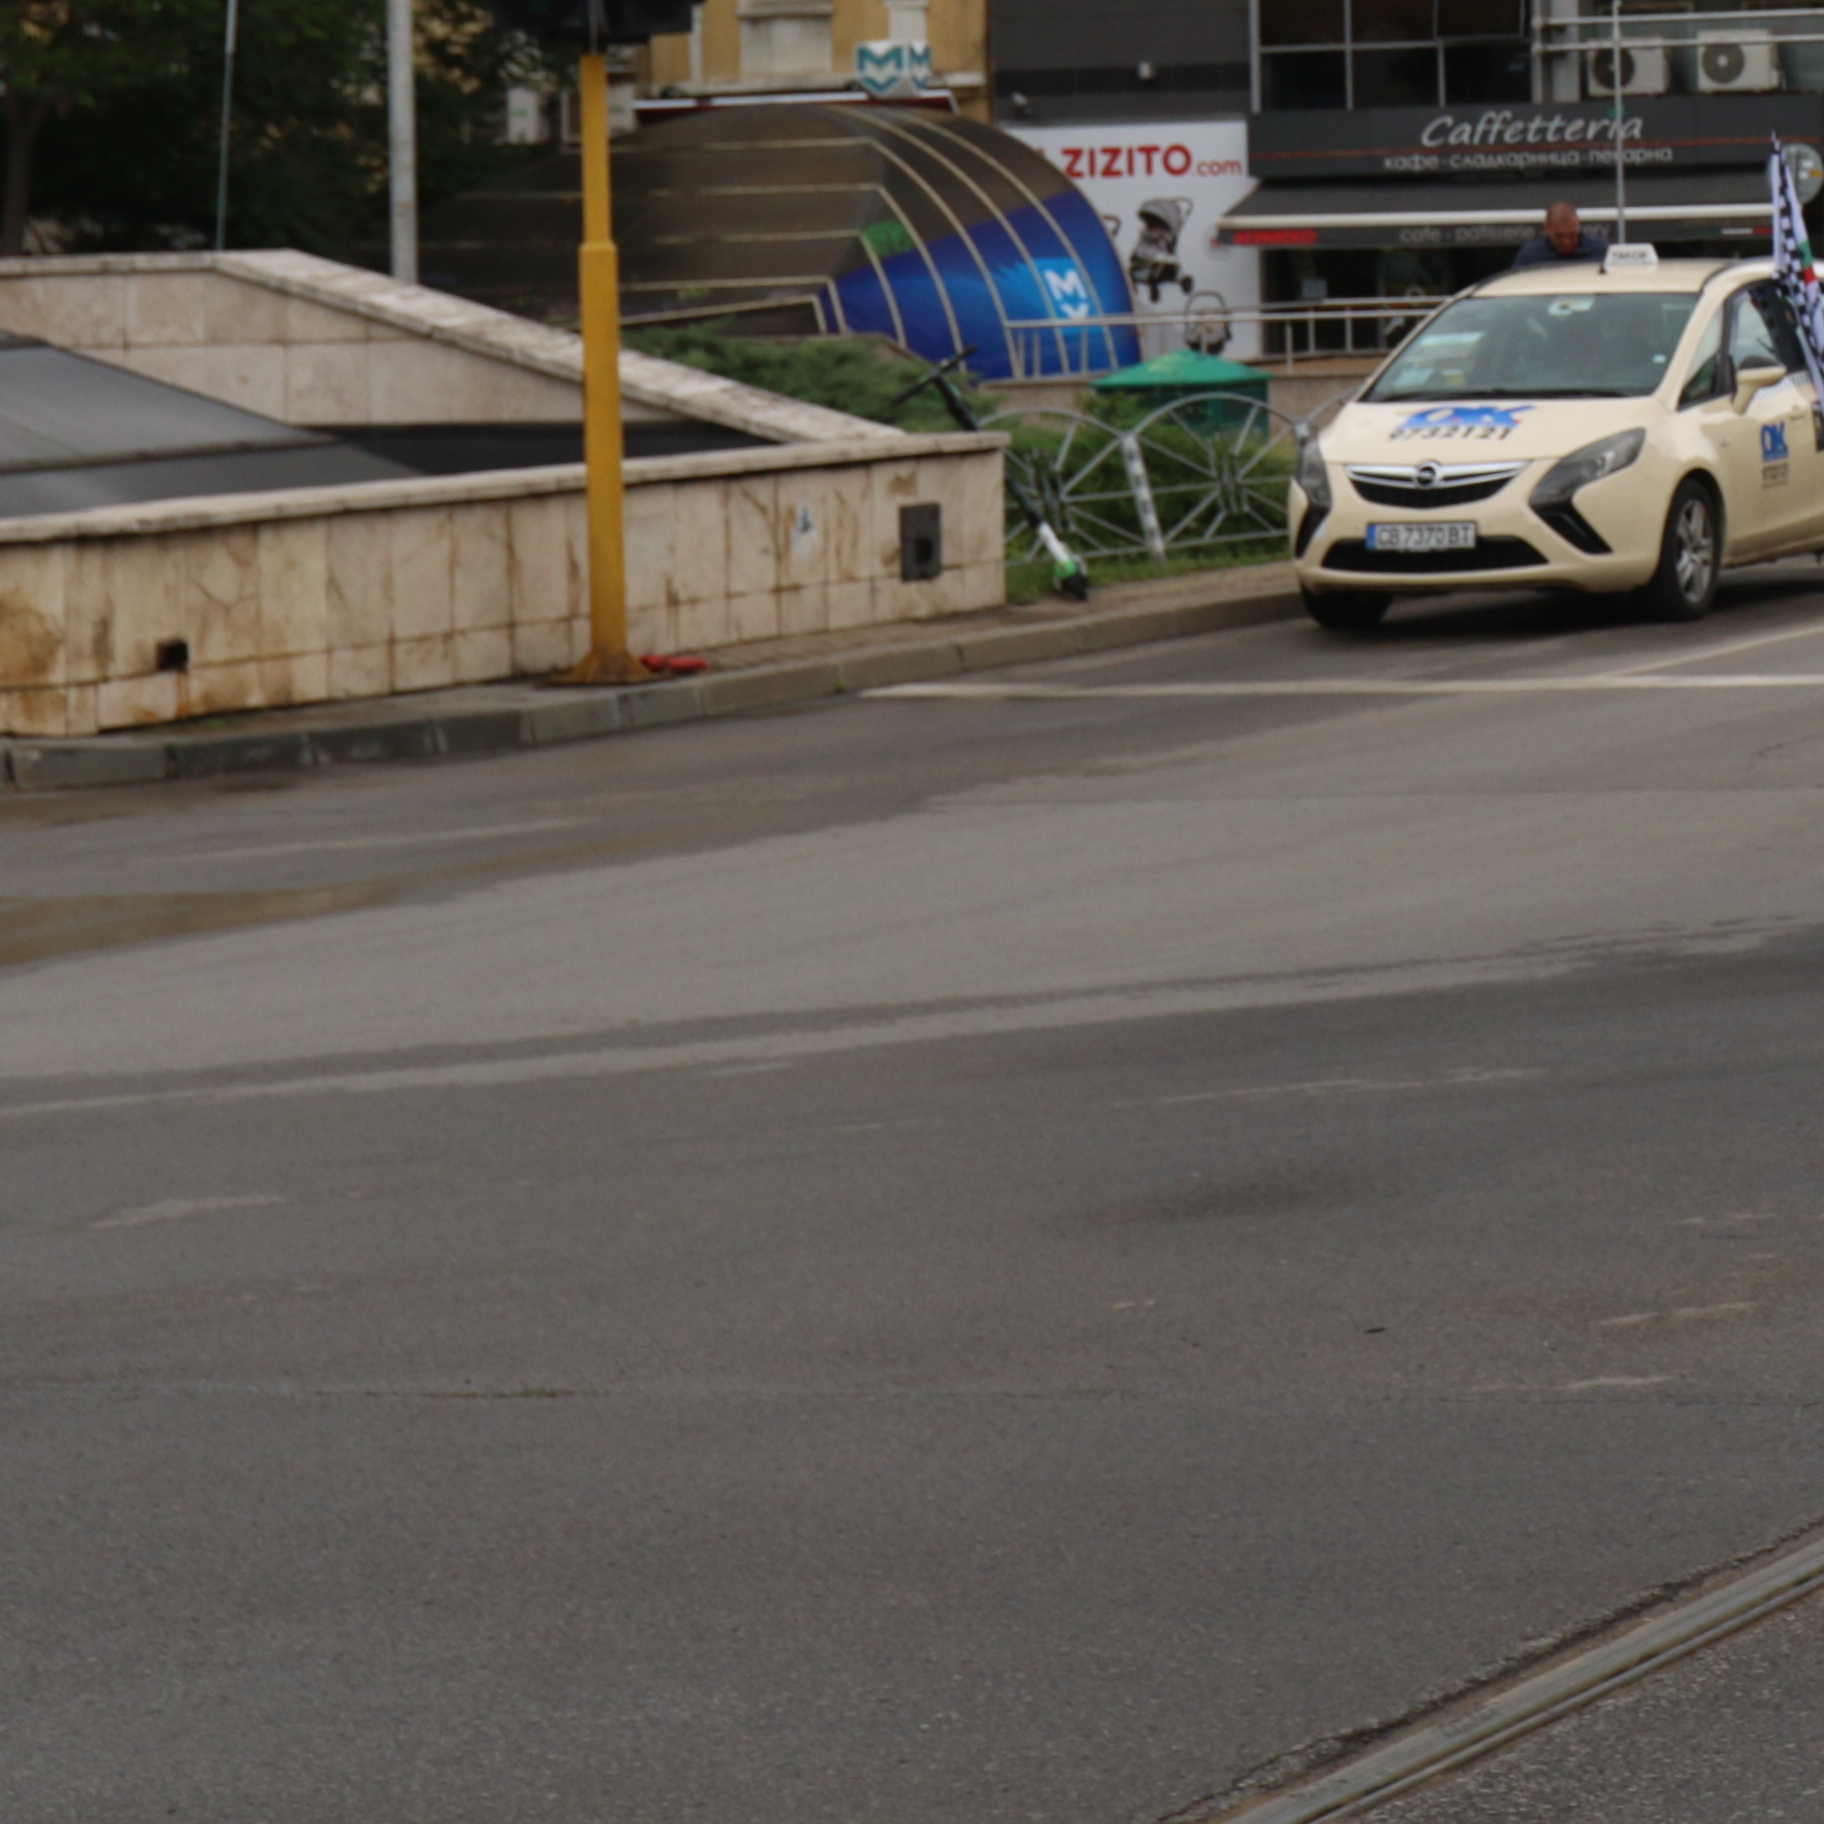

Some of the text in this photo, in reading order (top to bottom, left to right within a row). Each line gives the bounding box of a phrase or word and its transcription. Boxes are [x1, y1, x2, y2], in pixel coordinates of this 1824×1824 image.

[1419, 110, 1643, 147] Caffetteria
[1384, 153, 1439, 171] кафе
[1452, 149, 1580, 169] сладкарница
